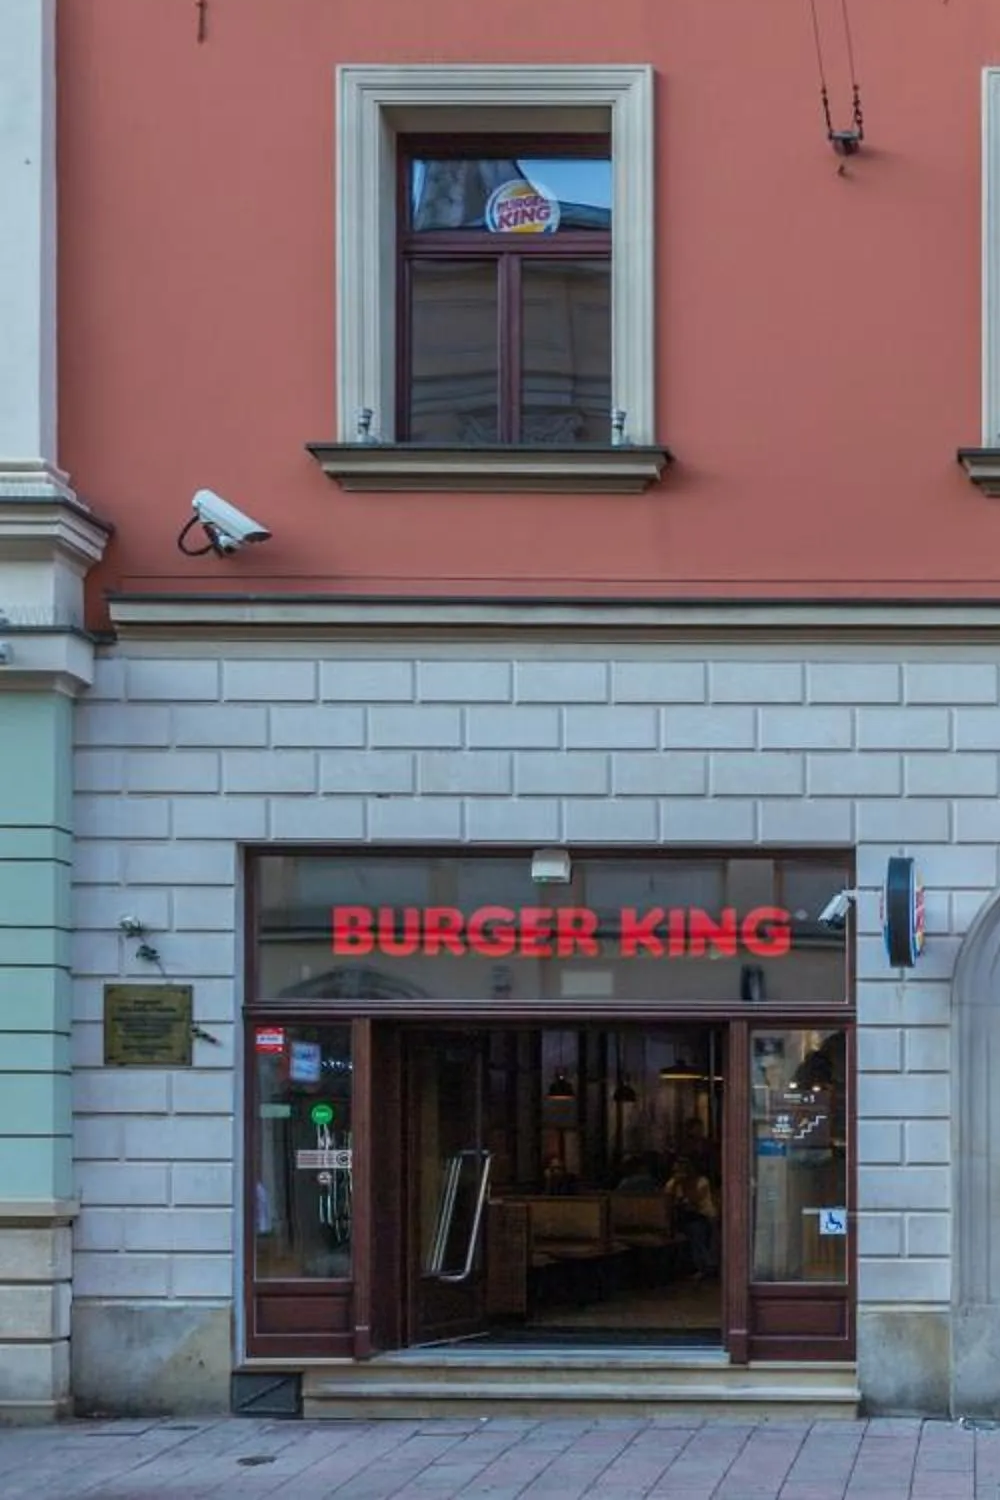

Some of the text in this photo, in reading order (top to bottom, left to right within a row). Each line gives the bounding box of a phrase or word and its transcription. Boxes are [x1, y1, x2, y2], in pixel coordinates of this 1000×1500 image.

[498, 206, 551, 229] KING
[332, 905, 791, 957] BURGER KING
